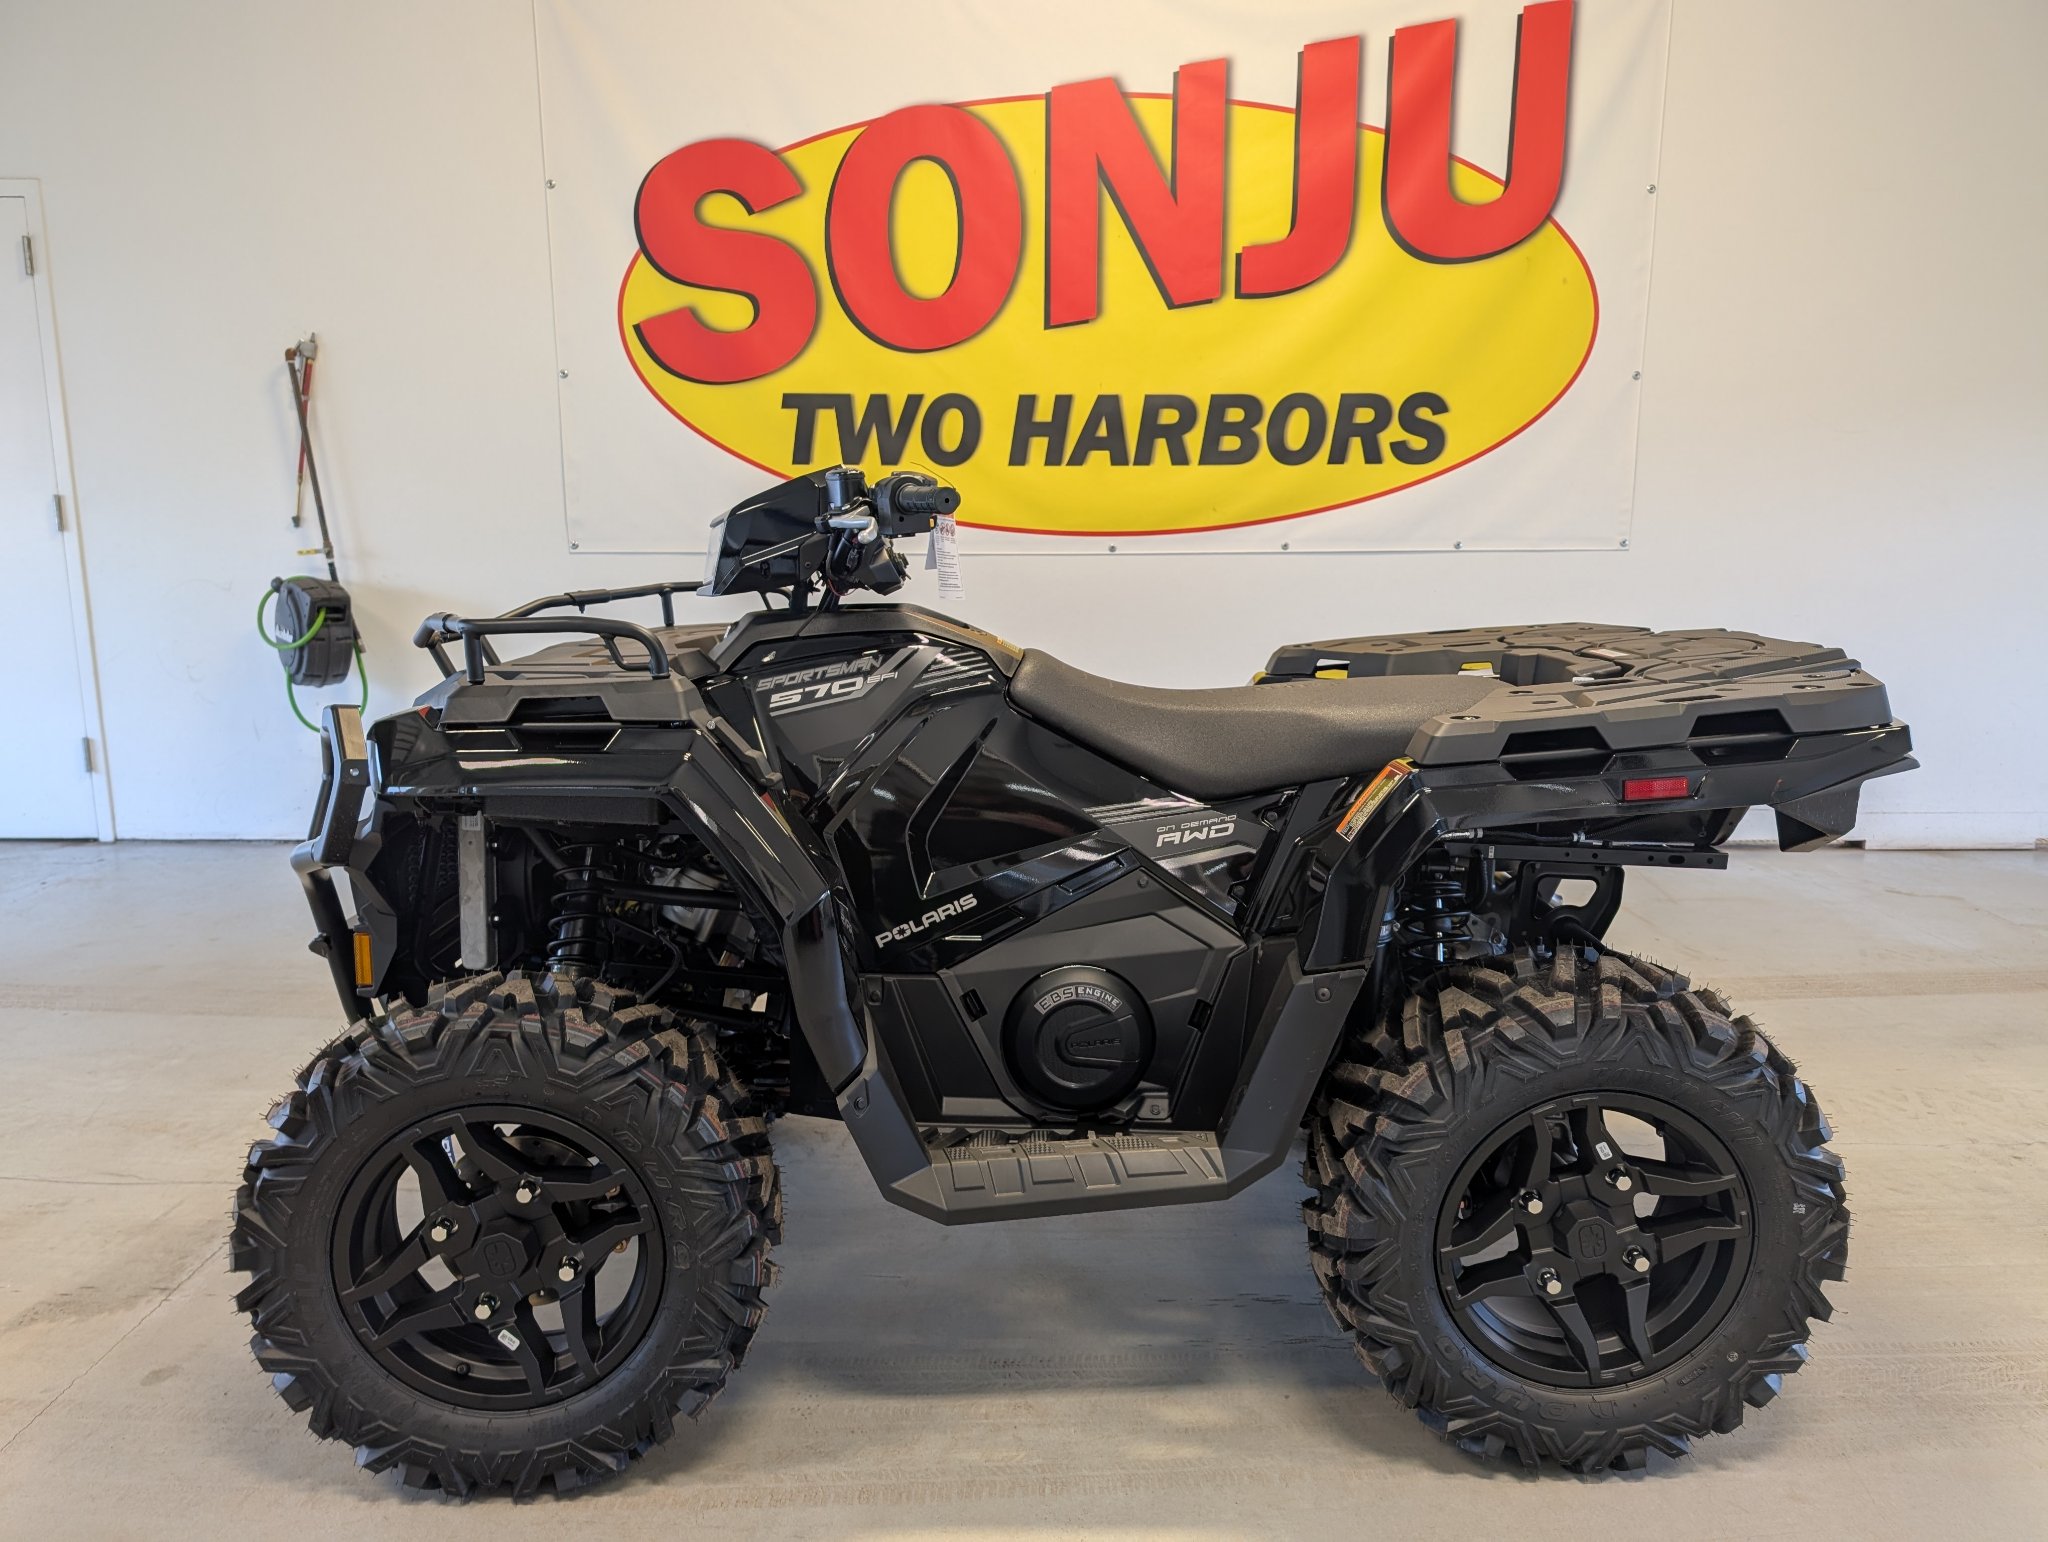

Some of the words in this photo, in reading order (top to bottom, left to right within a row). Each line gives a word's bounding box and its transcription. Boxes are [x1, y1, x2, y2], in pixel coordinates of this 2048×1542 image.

[633, 0, 1575, 384] SONJU
[781, 393, 981, 466] TWO
[1008, 391, 1449, 467] HARBORS
[756, 654, 883, 692] SPORTSMAN
[770, 677, 864, 708] 570
[866, 672, 898, 684] EFI
[1156, 823, 1235, 848] AWD
[1181, 814, 1237, 829] DEMAND
[875, 893, 978, 949] POLARIS
[1038, 987, 1073, 1010] EBS
[1077, 986, 1120, 1006] ENGINE
